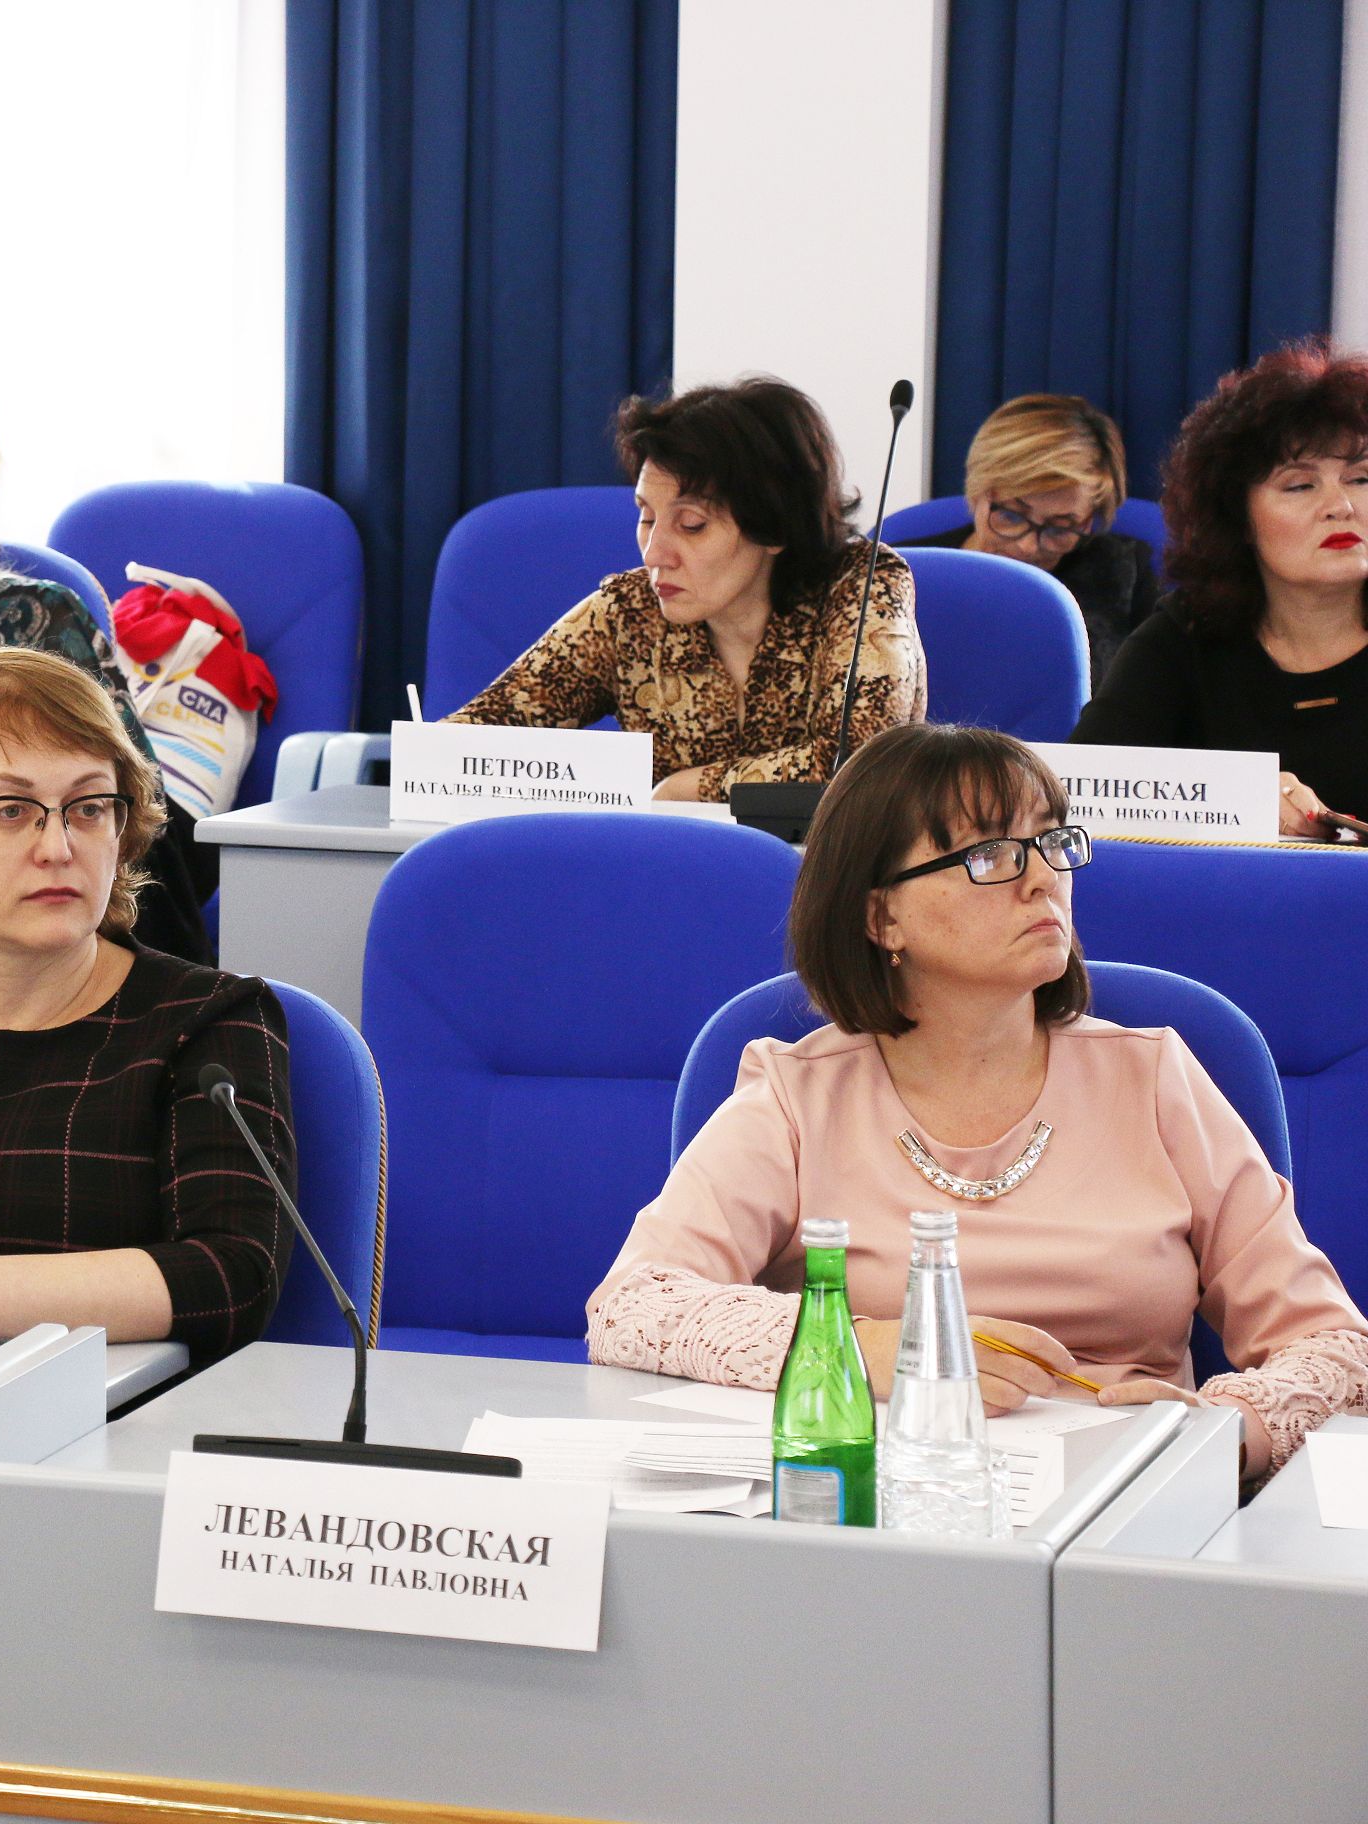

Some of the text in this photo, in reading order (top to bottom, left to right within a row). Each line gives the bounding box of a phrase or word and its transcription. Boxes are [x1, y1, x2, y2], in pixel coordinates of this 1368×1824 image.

[462, 756, 577, 781] ПЕТРОВА
[404, 780, 634, 807] НАТАЛЬЯ ВЛАДИМИРОВНА
[1116, 807, 1241, 826] НИКОЛАЕВНА
[204, 1503, 553, 1567] ЛЕВАНДОВСКАЯ
[220, 1549, 530, 1602] НАТАЛЬЯ ПАВЛОВНА
